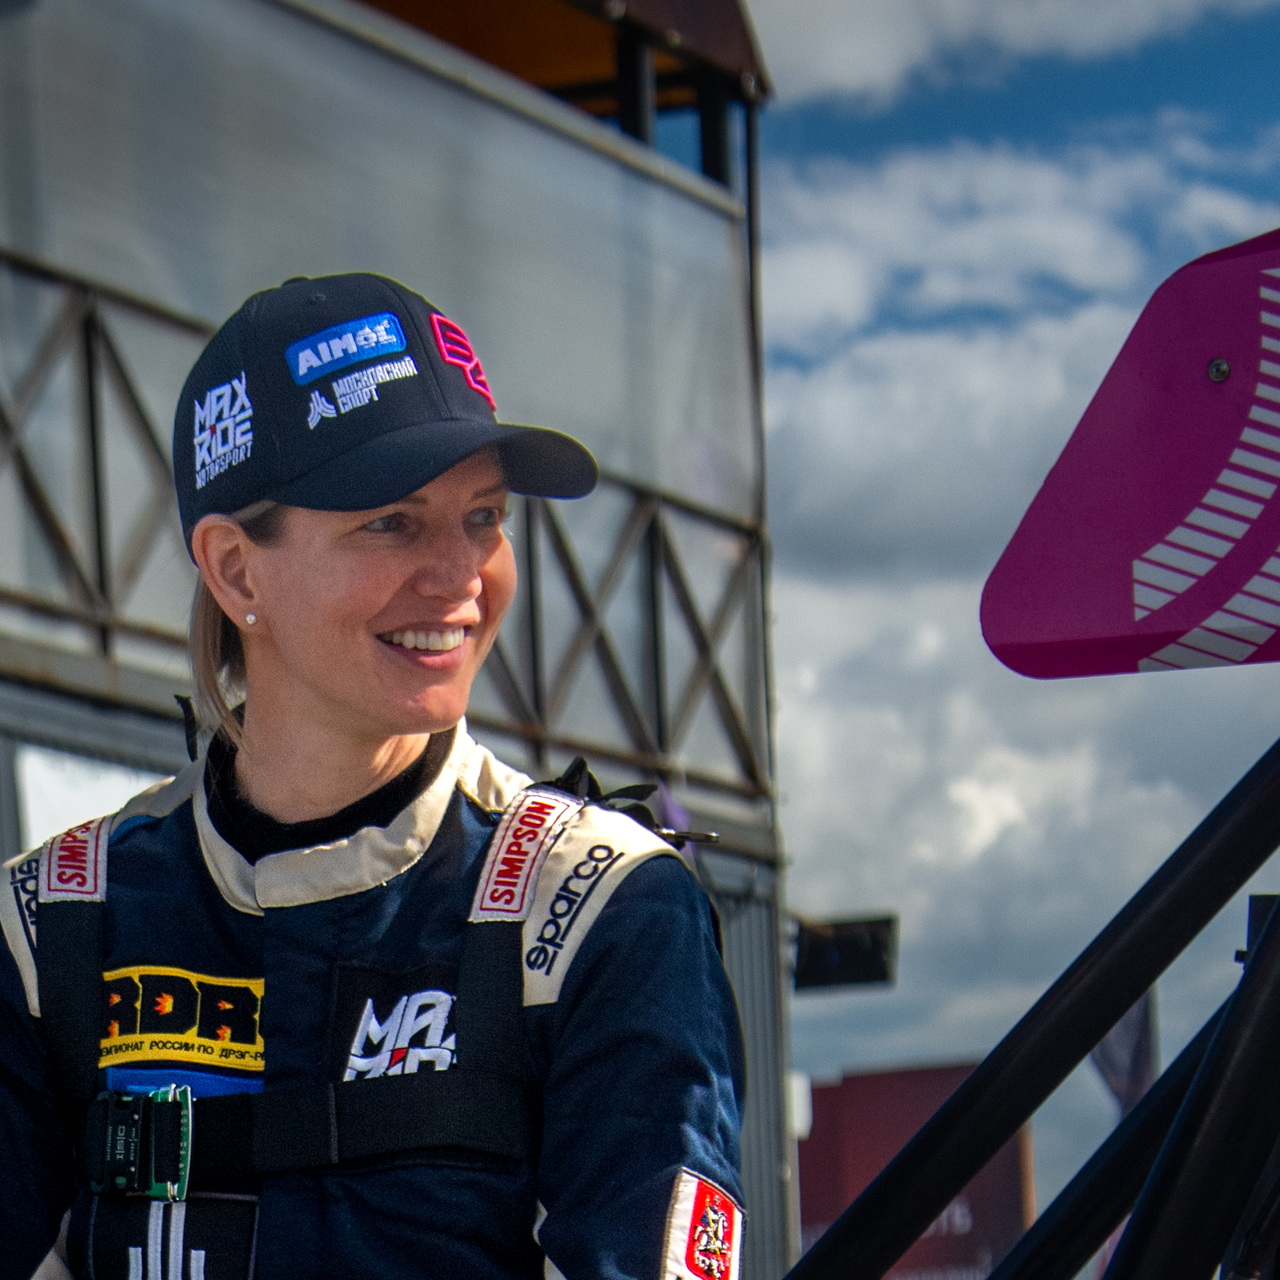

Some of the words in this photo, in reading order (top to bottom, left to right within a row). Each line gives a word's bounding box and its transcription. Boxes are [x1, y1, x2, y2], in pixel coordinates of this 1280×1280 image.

[194, 369, 252, 438] MAX
[337, 385, 378, 413] СПОРТ
[194, 408, 253, 472] RIDE
[196, 441, 253, 489] MOTORSPORT
[489, 801, 556, 905] SIMPSON
[101, 1041, 145, 1058] ЕМПИОНАТ
[149, 1040, 195, 1053] РОССИИ
[197, 1044, 214, 1055] ПО
[351, 988, 457, 1057] MA
